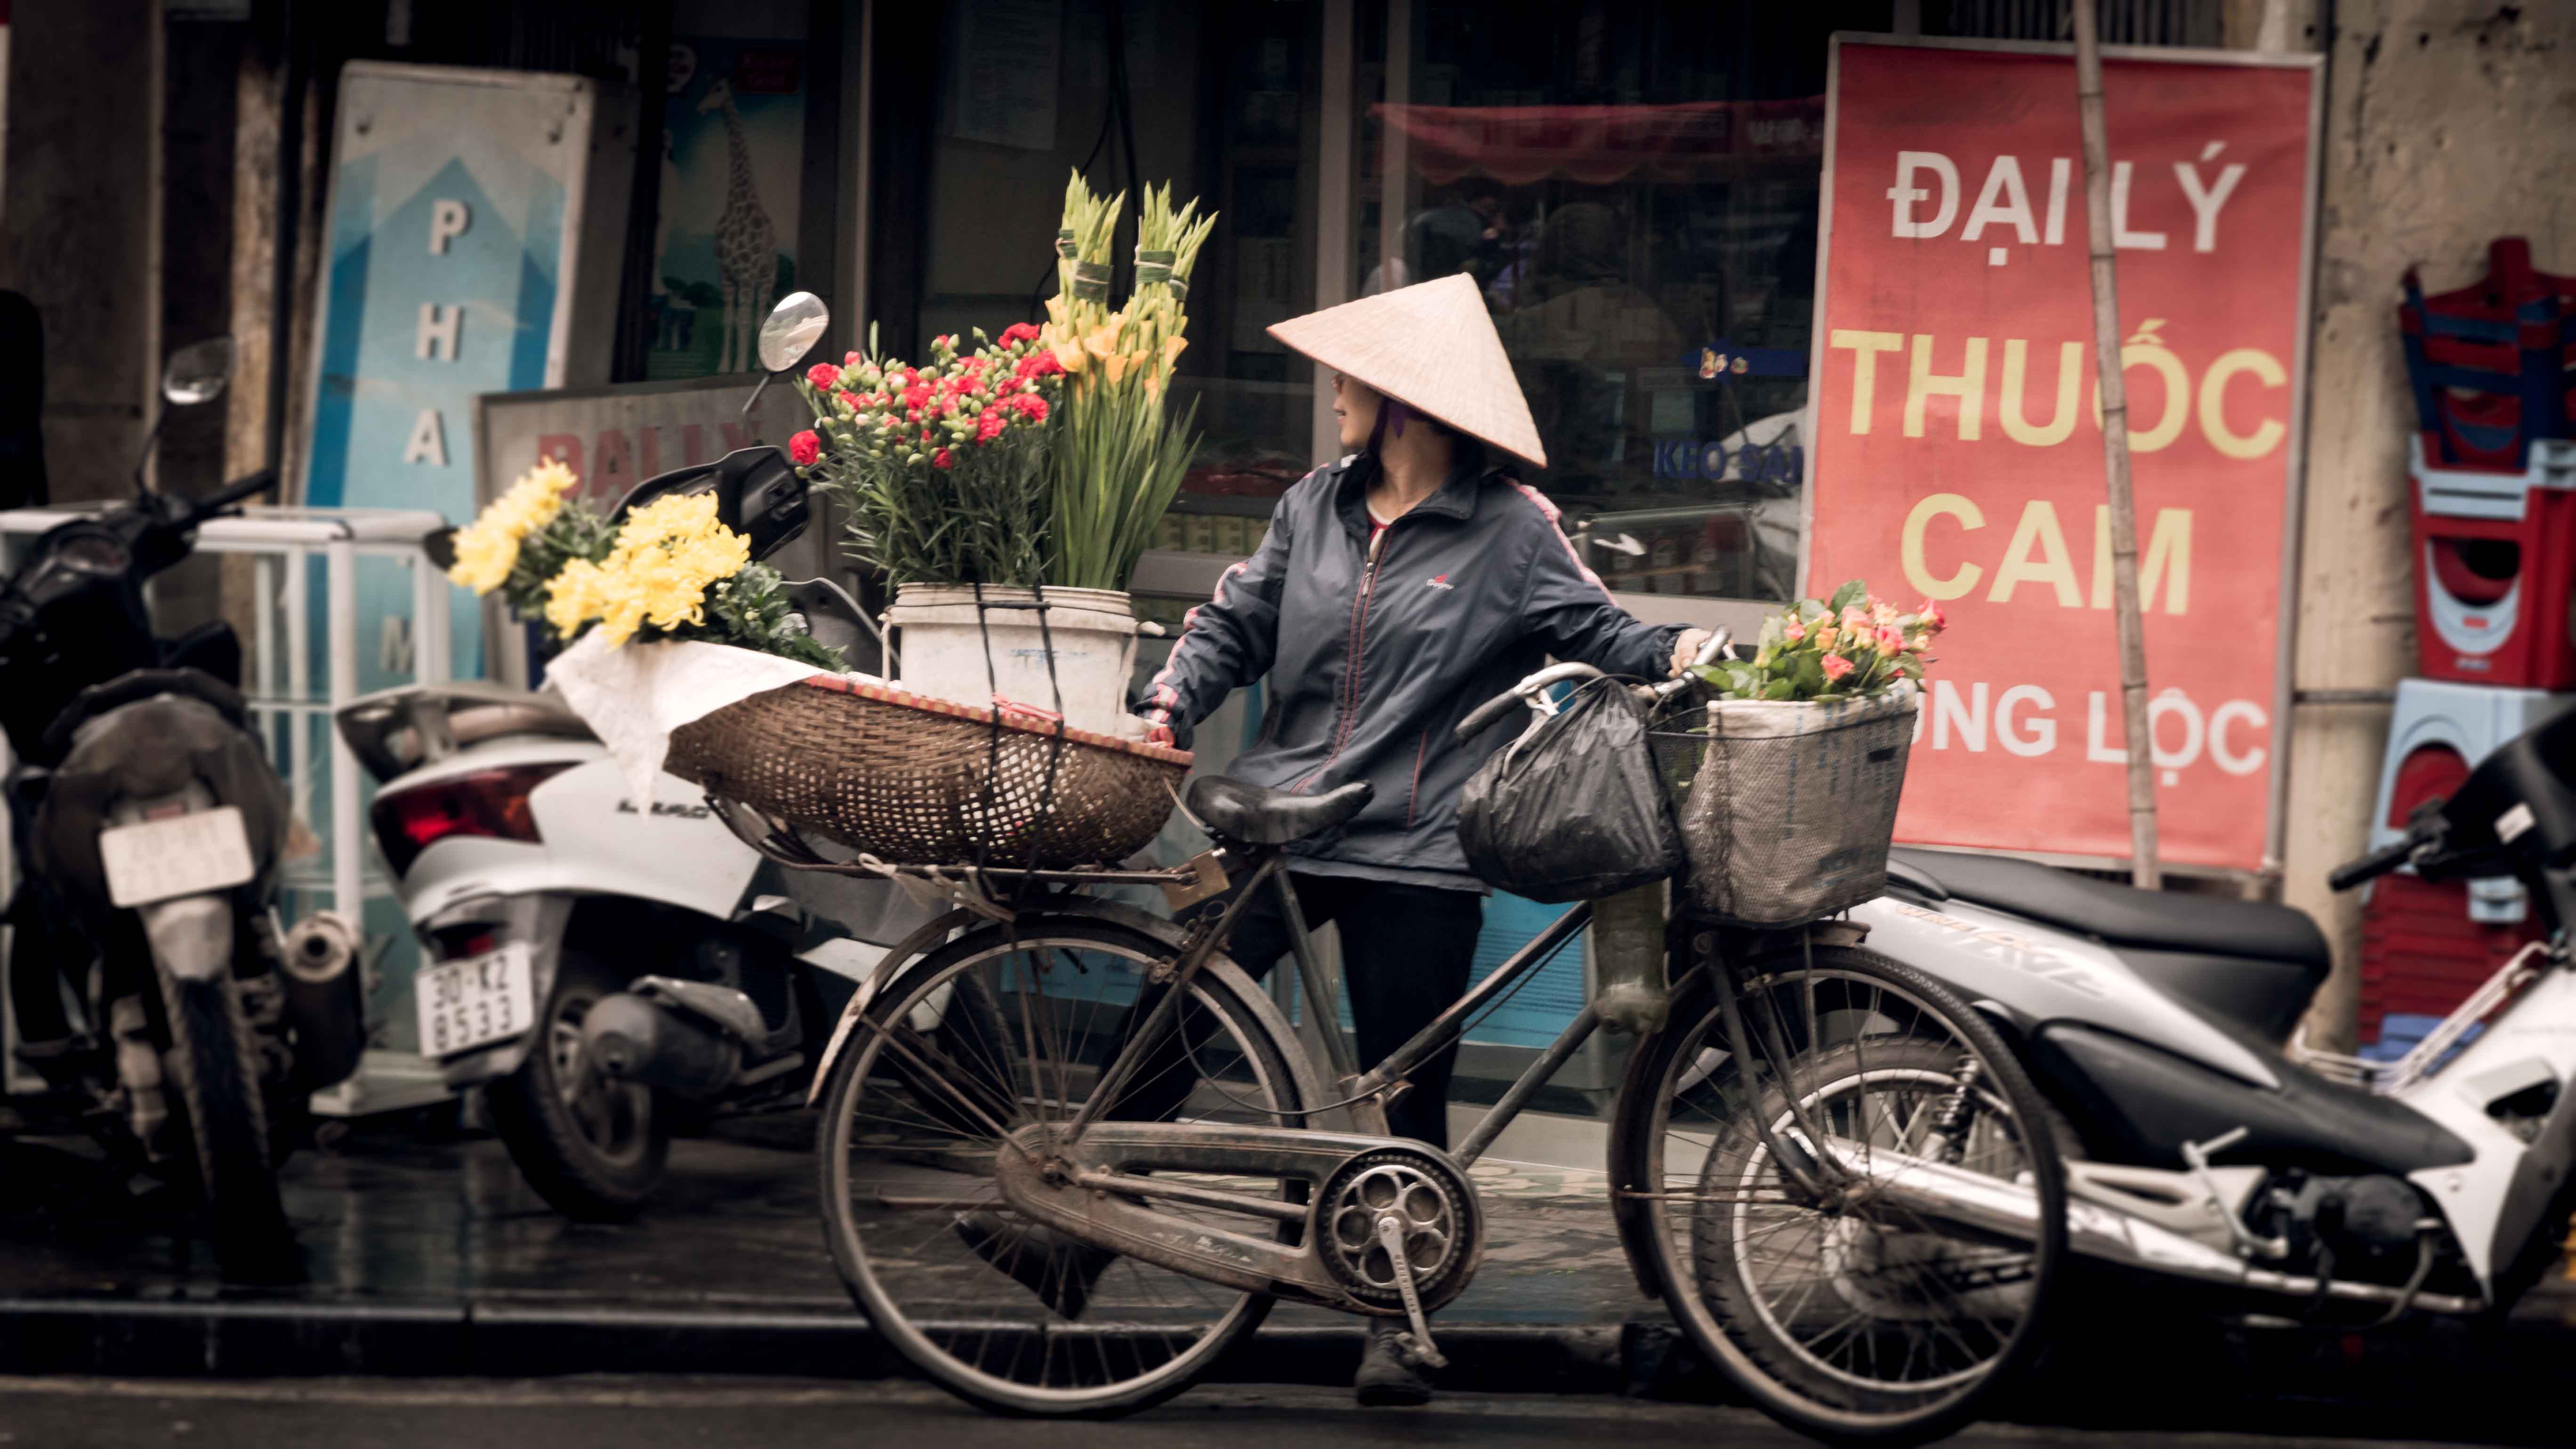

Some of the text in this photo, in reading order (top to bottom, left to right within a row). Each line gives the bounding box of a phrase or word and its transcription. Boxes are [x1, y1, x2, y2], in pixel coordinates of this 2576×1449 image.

[1885, 140, 2249, 267] ĐẠI LÝ
[1829, 318, 2288, 460] THUỐC
[1901, 492, 2193, 616] CAM
[1910, 679, 2267, 787] NG LỘC
